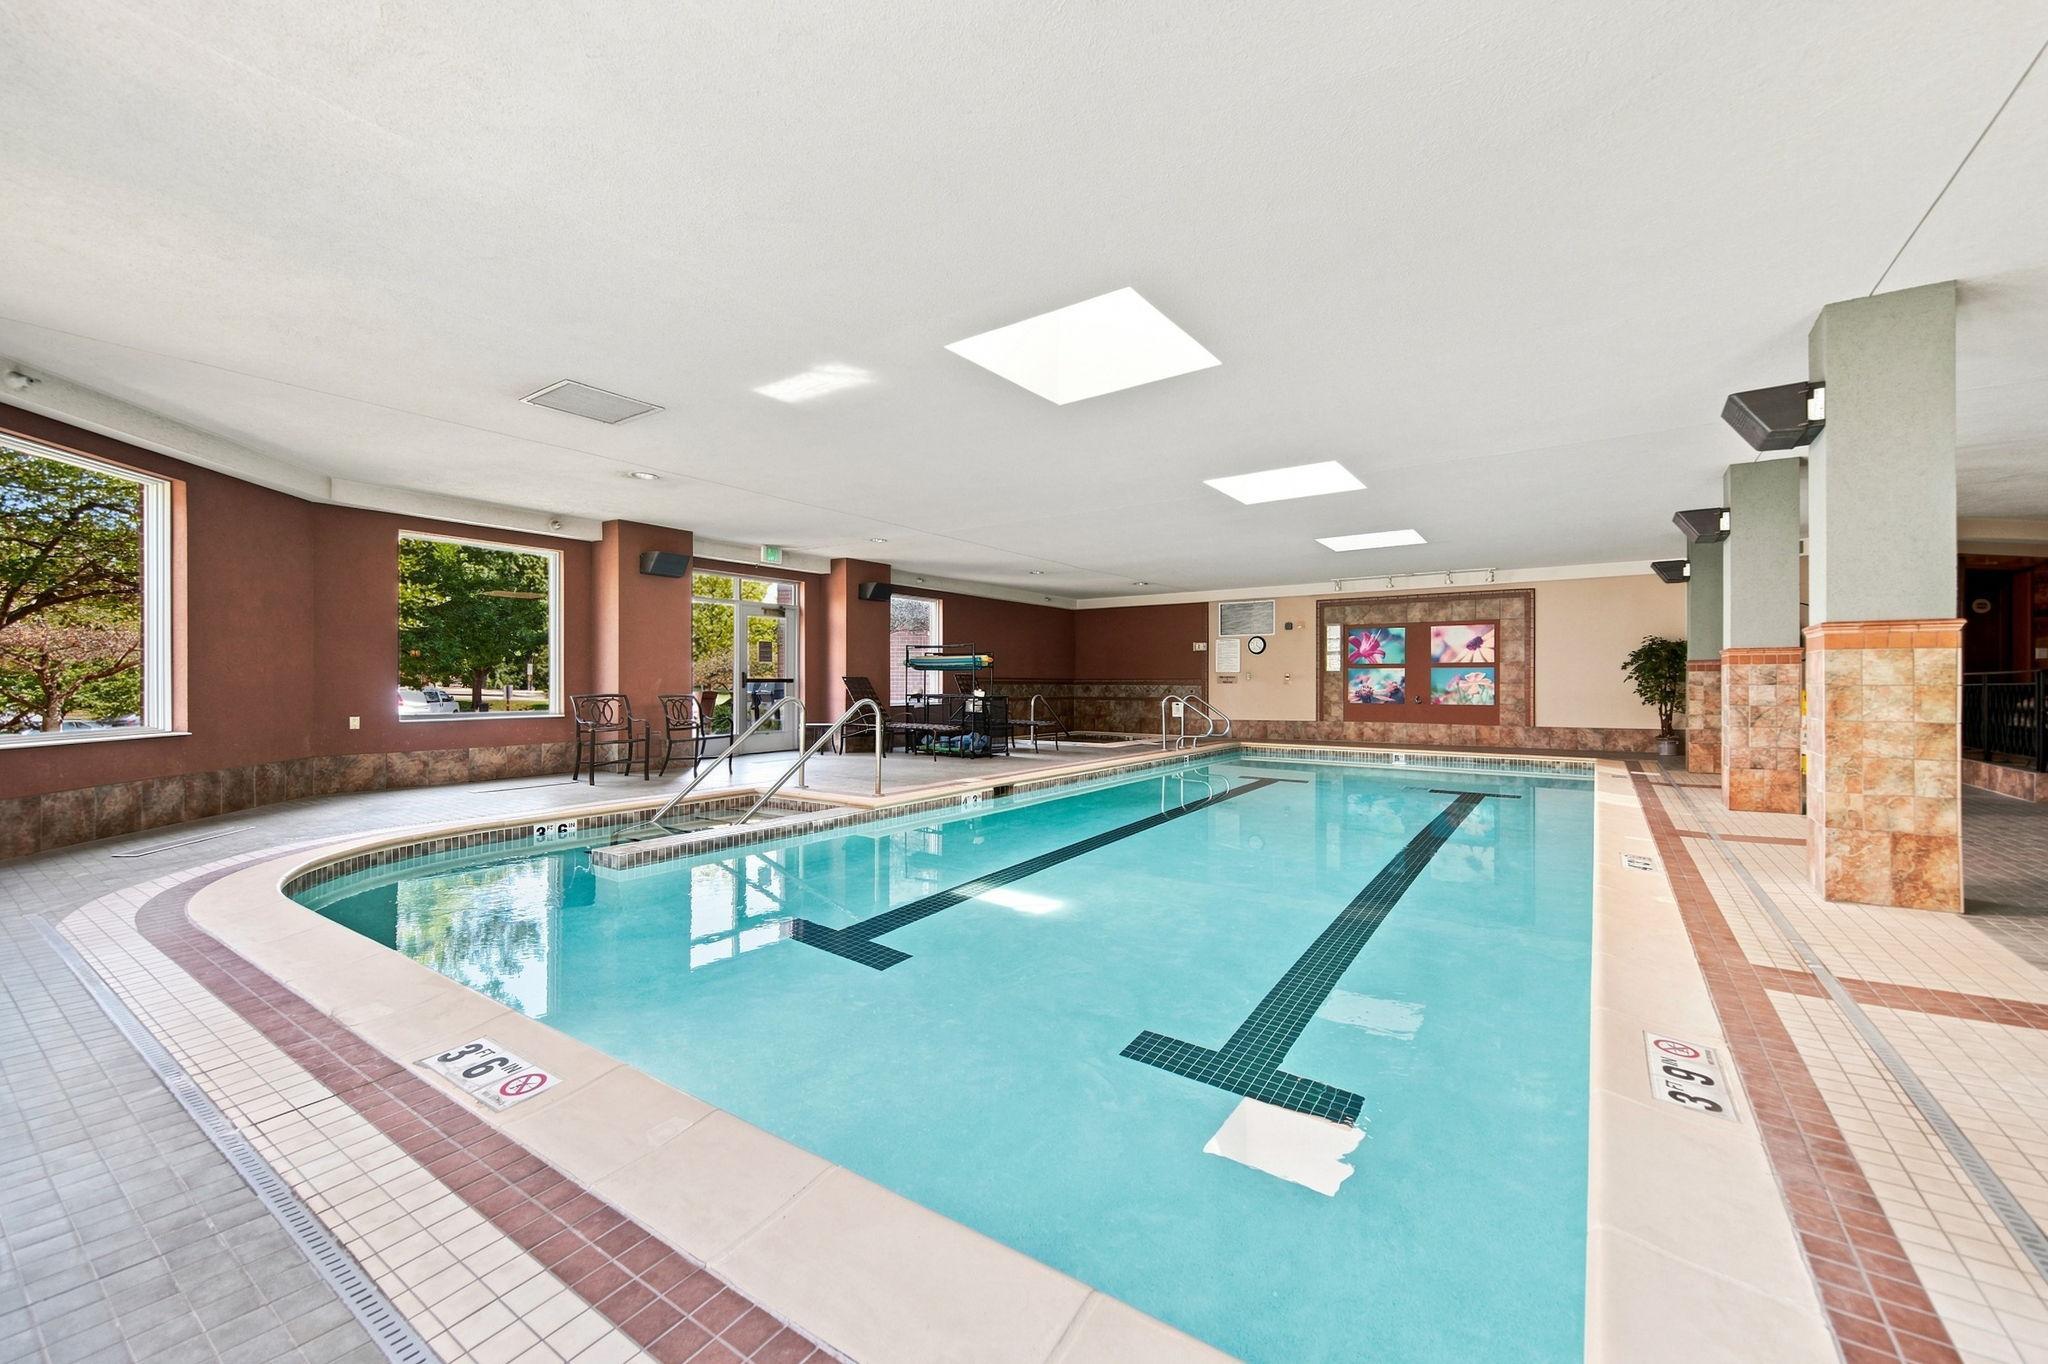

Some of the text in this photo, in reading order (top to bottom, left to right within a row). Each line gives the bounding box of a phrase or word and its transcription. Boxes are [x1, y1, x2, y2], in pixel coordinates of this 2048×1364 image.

[536, 826, 546, 837] 3
[437, 1043, 522, 1079] 3 FT 6 IN
[1660, 1056, 1723, 1112] 3 FT 9 IN
